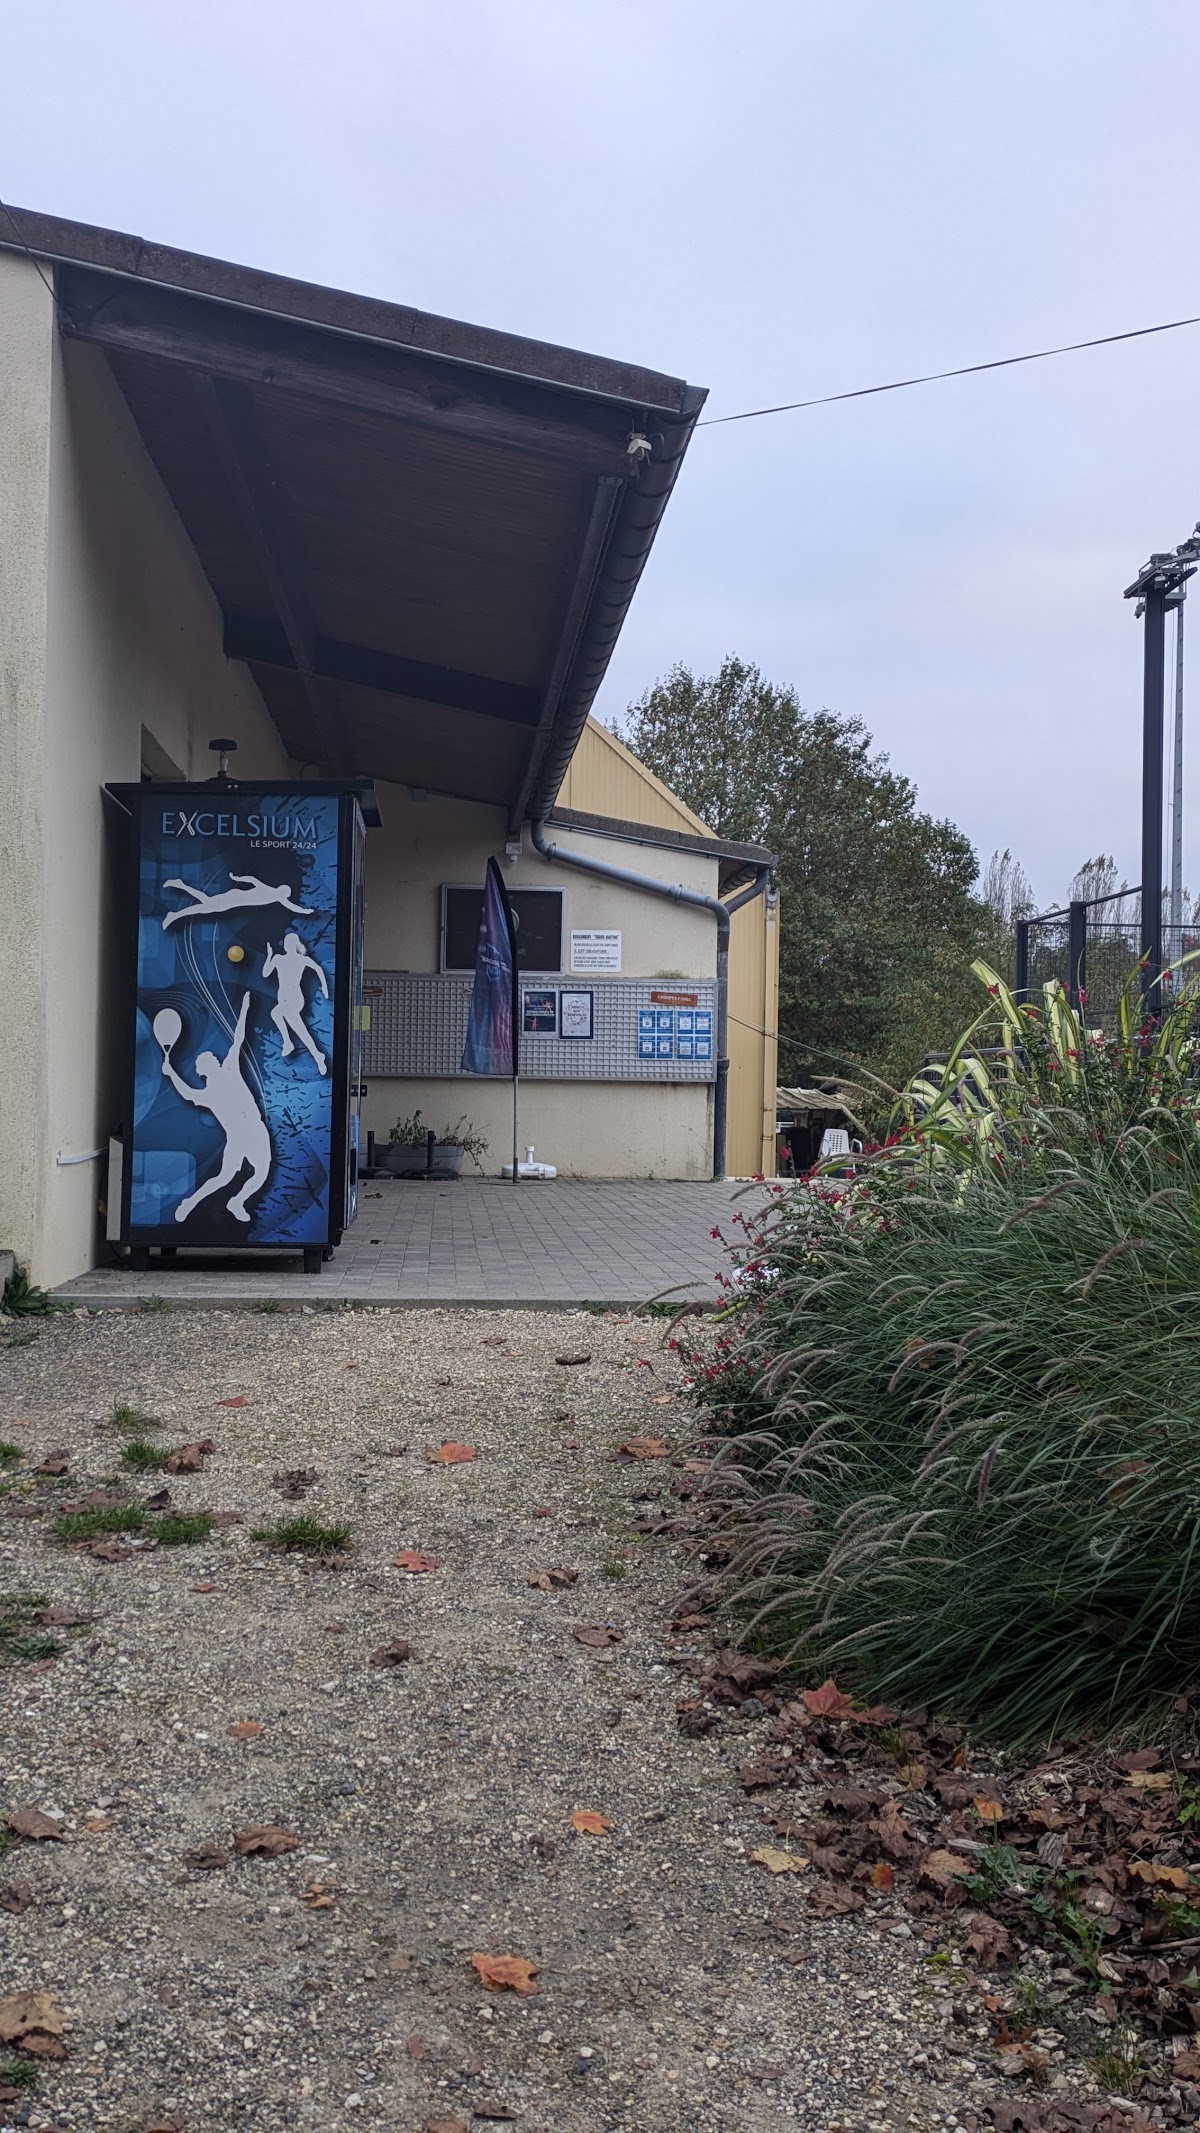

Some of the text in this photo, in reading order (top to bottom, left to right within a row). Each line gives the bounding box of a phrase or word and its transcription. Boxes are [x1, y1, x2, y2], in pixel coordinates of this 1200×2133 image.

[163, 810, 317, 838] EXCELSIUM
[250, 840, 317, 849] LE SPORT 24/24
